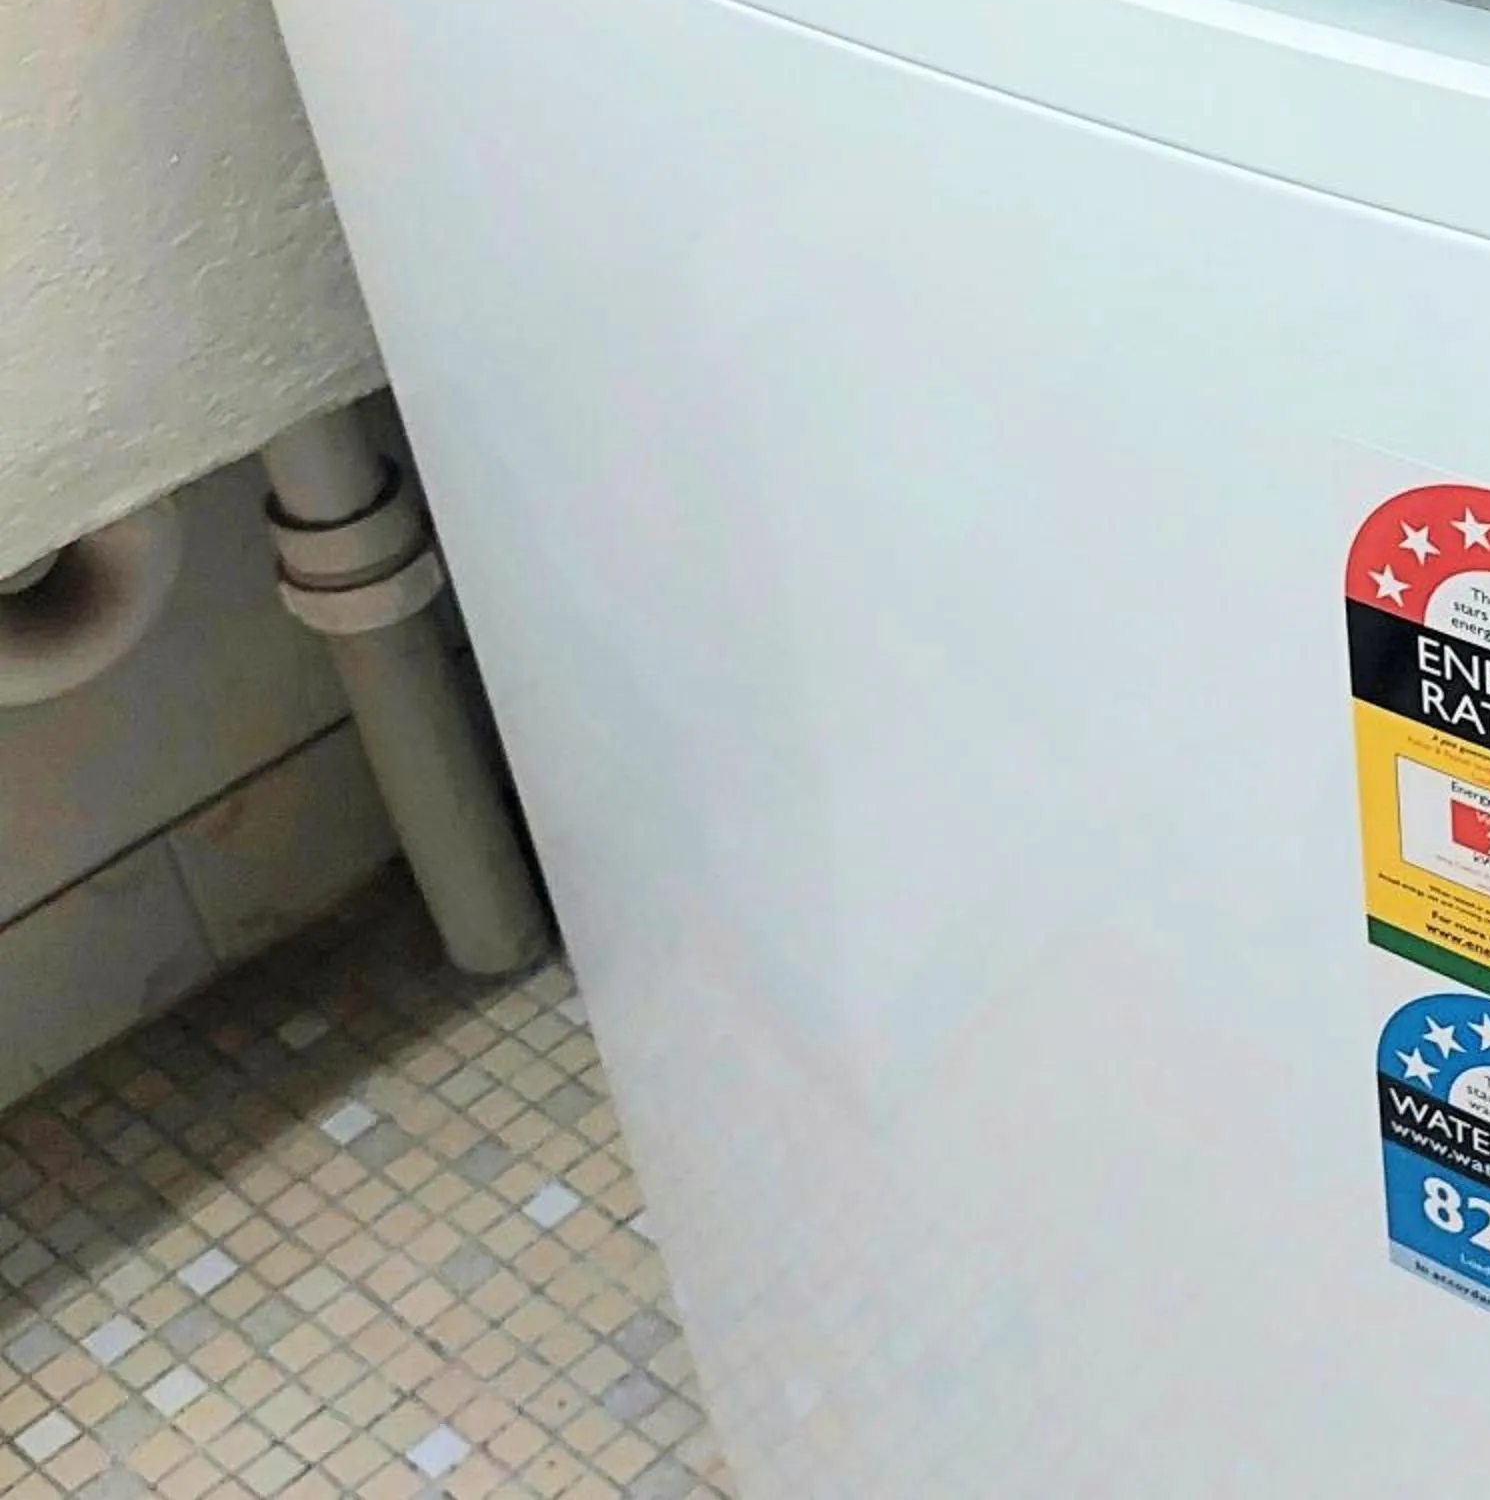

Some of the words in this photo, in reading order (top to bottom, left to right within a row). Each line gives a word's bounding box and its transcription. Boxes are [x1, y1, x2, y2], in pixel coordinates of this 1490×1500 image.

[1452, 600, 1489, 623] stars
[1431, 909, 1452, 924] For
[1454, 921, 1486, 940] more
